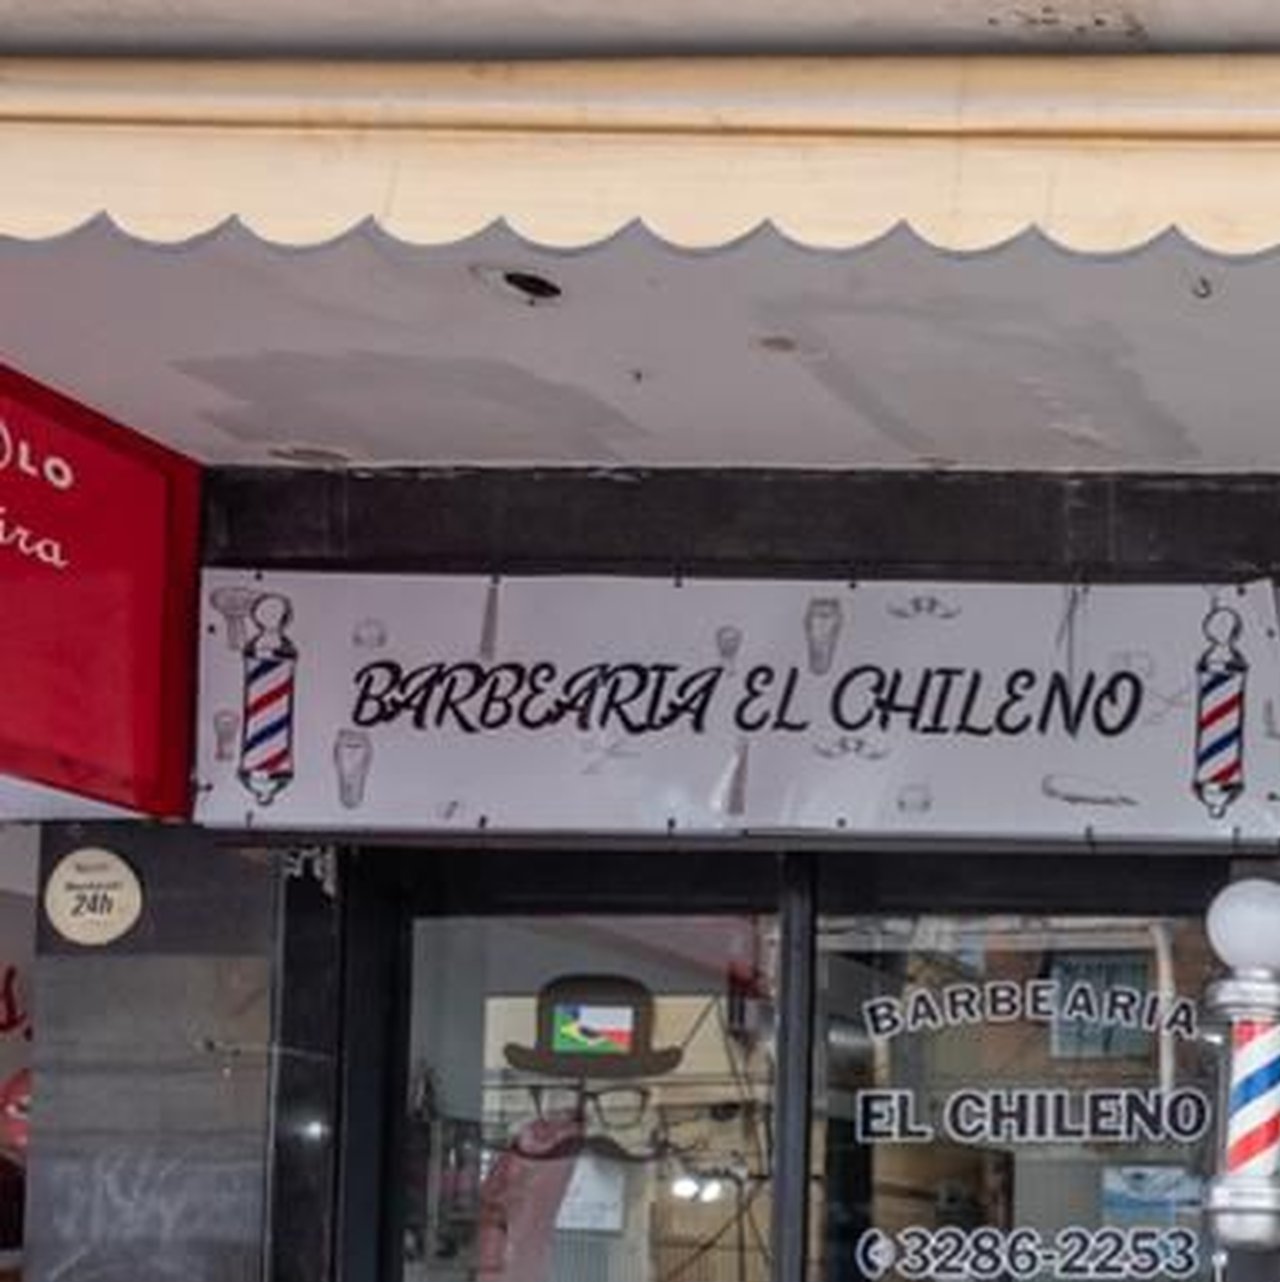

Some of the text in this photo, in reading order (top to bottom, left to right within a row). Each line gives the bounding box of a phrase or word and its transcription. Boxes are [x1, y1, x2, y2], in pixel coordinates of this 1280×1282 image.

[352, 661, 1143, 738] BARBEARIA EL CHILENO
[70, 892, 115, 917] 24h
[863, 981, 1199, 1041] BARBEARIA
[856, 1088, 1212, 1142] EL CHILENO
[896, 1226, 1199, 1279] 3286-2253
